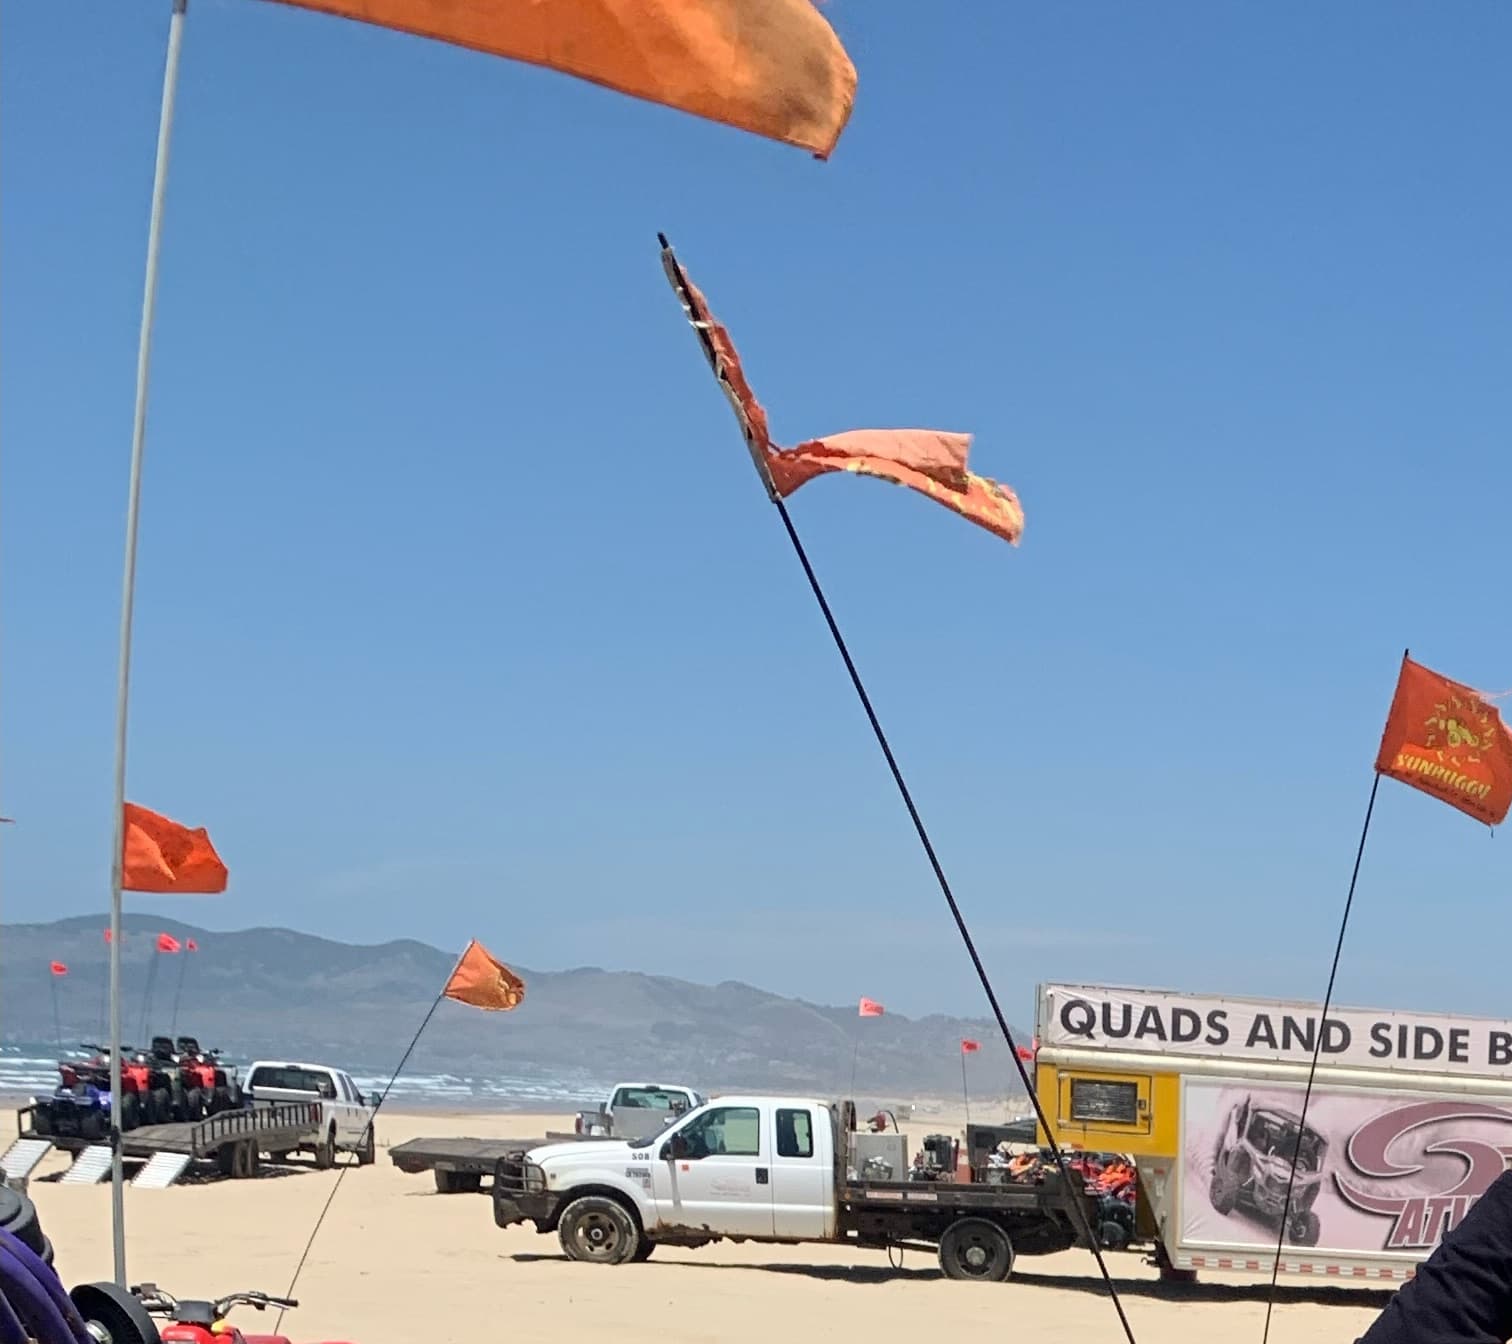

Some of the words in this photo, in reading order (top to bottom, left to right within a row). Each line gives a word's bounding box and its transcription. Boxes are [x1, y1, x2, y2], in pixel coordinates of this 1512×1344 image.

[1059, 998, 1231, 1047] QUADS
[1245, 1012, 1352, 1054] AND
[1368, 1021, 1471, 1064] SIDE
